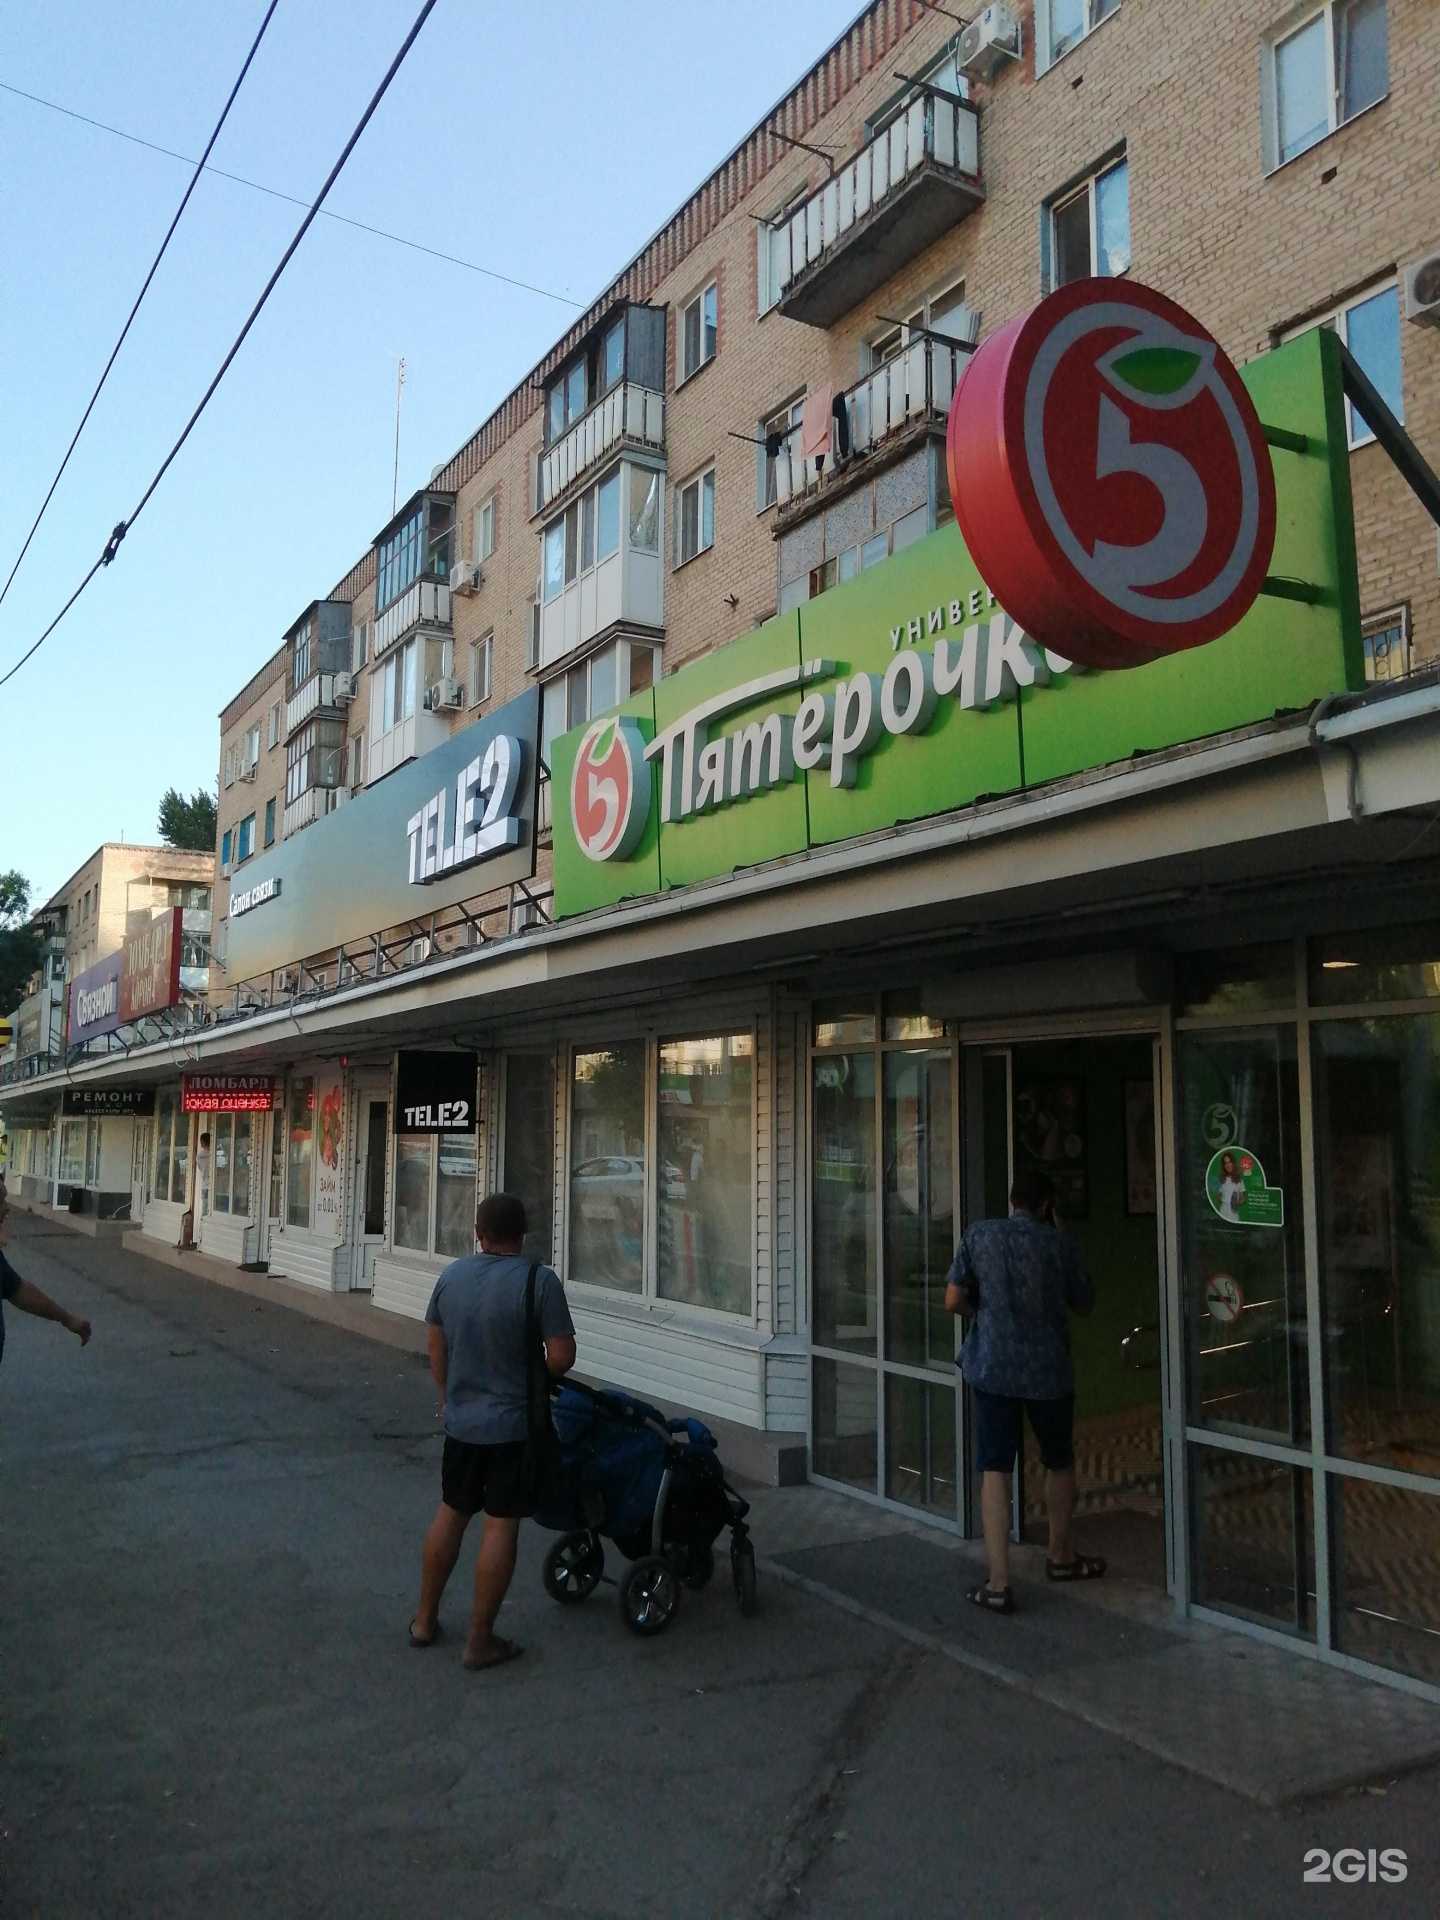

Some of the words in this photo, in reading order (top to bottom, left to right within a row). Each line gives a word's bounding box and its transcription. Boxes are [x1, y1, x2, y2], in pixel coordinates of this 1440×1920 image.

[643, 612, 1072, 823] Пятёрочк
[407, 734, 519, 884] TELE2
[229, 892, 251, 917] Салон
[251, 877, 275, 906] связи
[77, 977, 114, 1028] Связной
[72, 1092, 144, 1103] РЕМОНТ
[189, 1077, 269, 1090] ЛОМБАРД
[404, 1100, 469, 1127] TELE2
